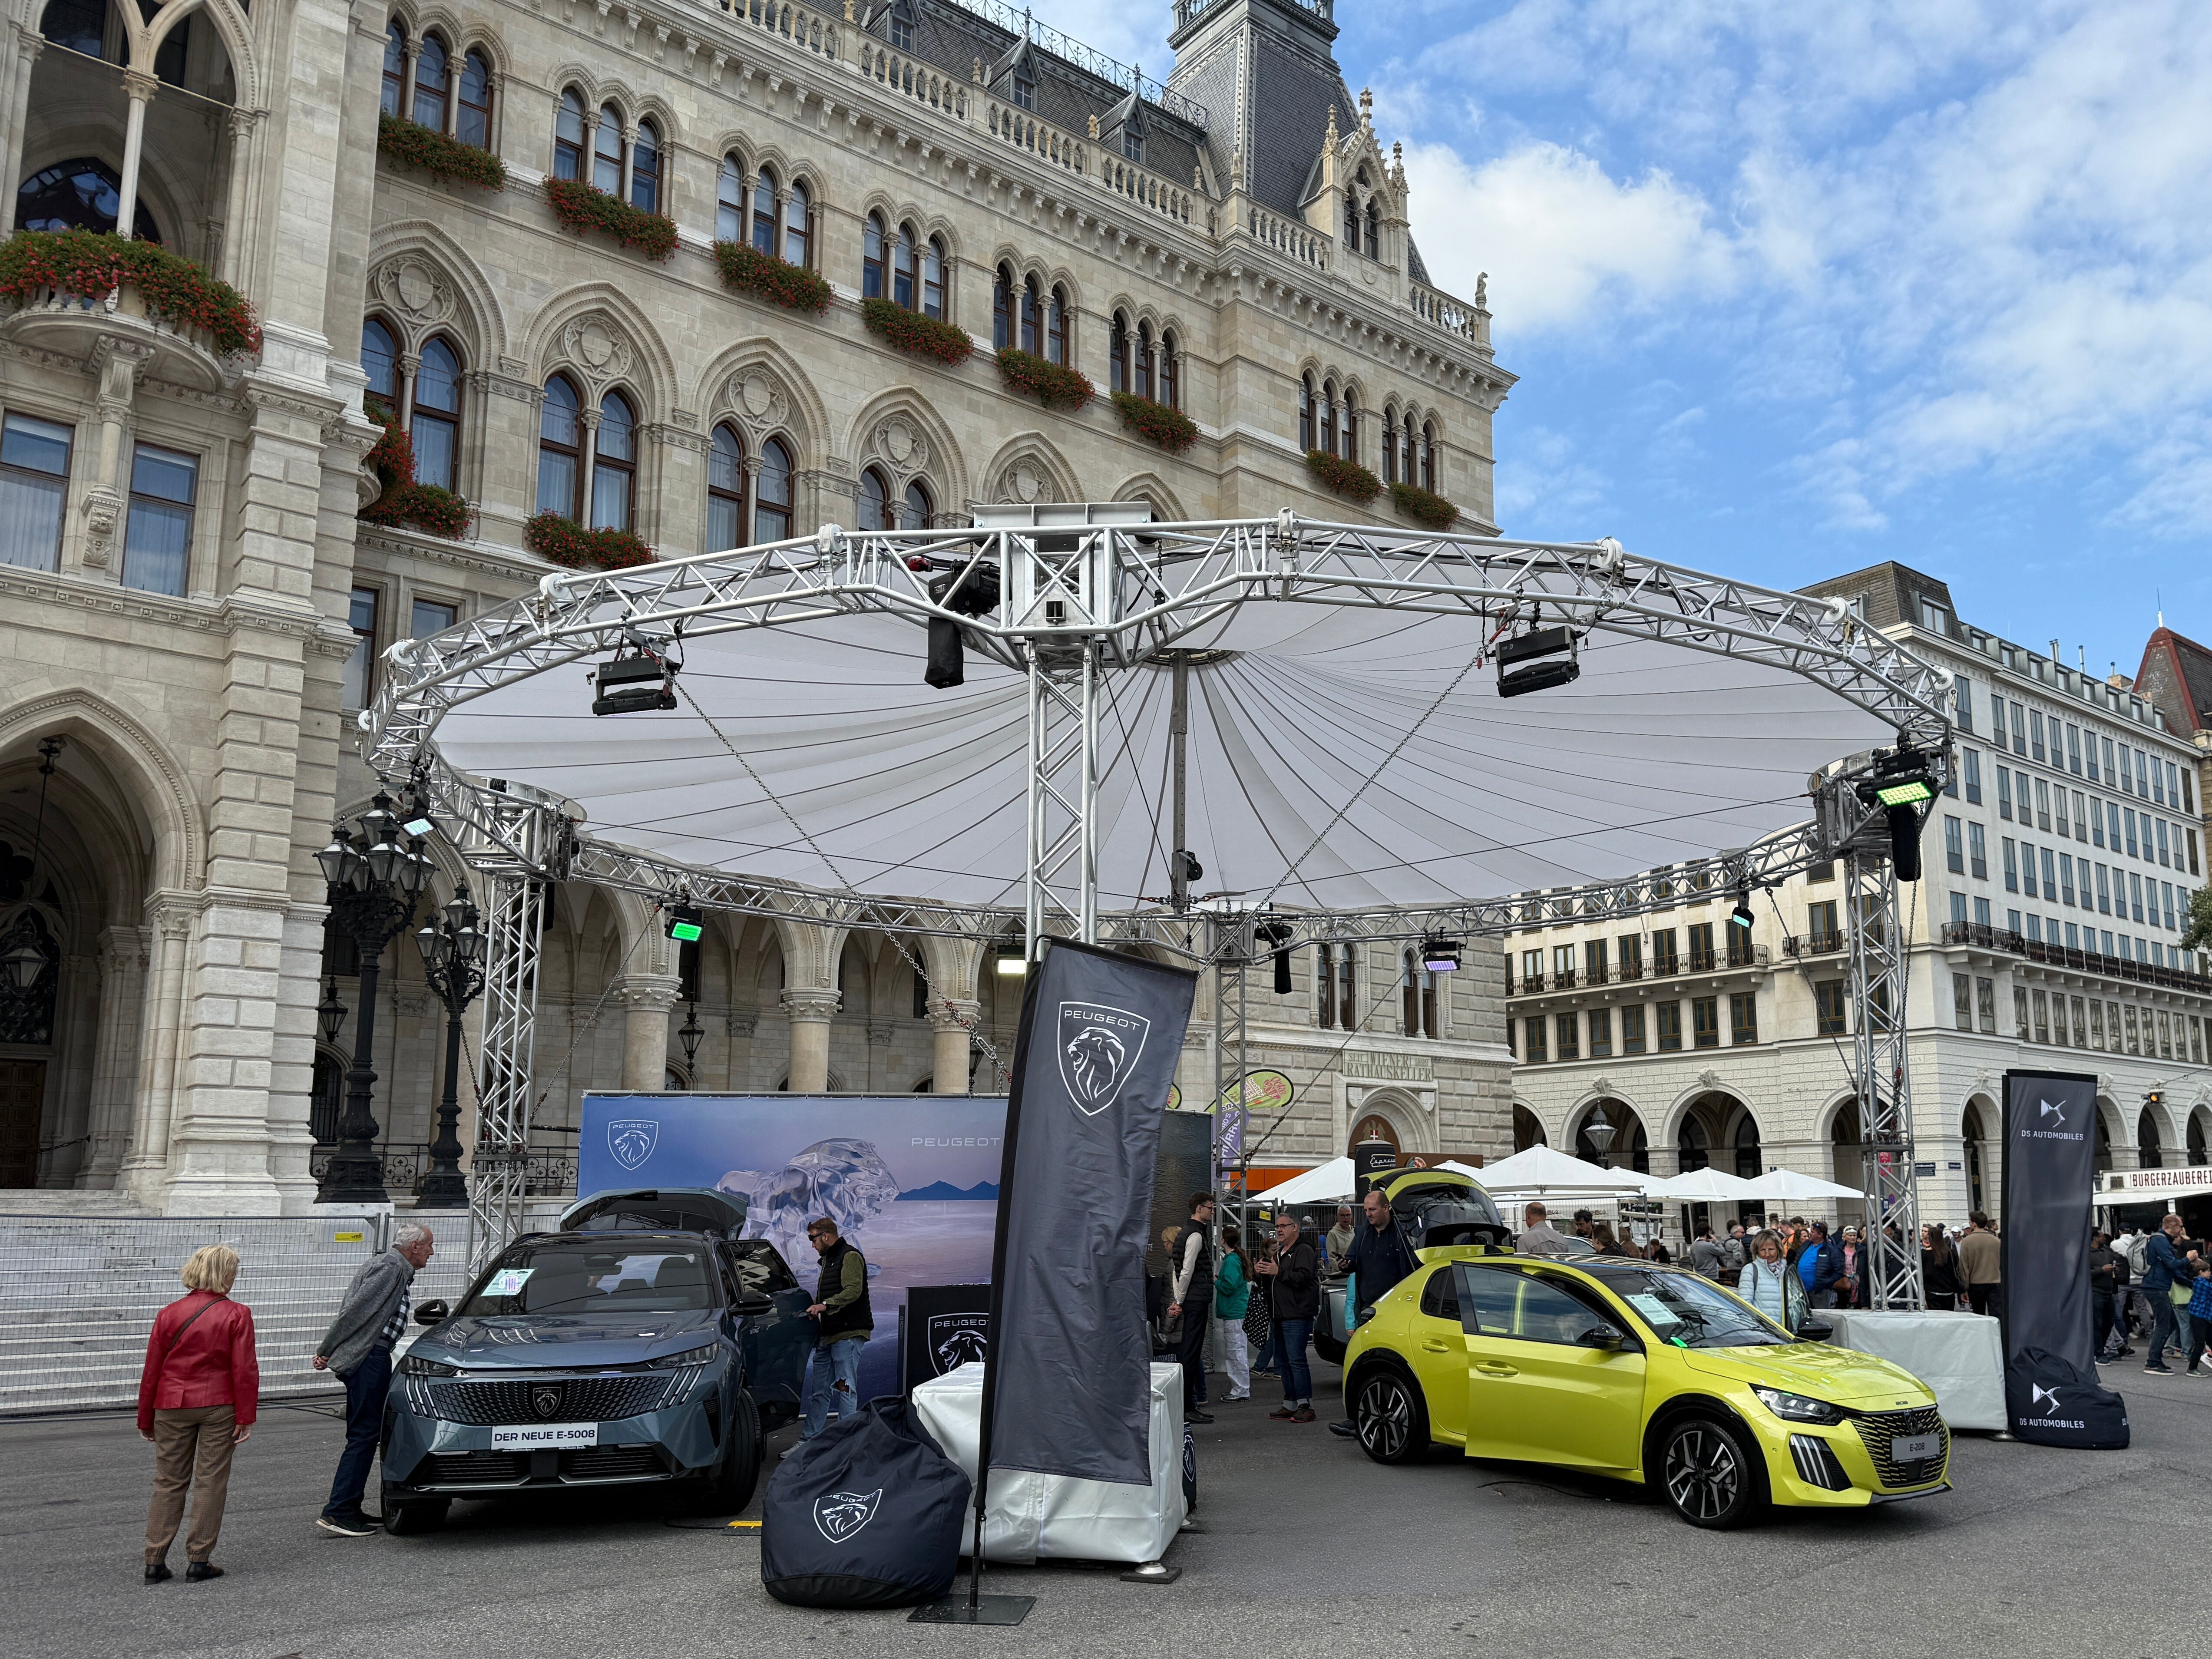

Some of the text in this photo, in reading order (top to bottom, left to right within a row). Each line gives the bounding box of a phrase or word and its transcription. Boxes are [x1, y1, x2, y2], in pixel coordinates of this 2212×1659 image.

[1065, 1010, 1140, 1030] PEUGEOT
[1349, 1052, 1429, 1068] SEIT WIENER 1899
[1347, 1062, 1433, 1081] RATHAUSKELLER
[2033, 1131, 2083, 1140] AUTOMOBILES
[911, 1137, 1000, 1147] PEUGEOT
[2133, 1170, 2212, 1187] BURGERZAUBEREI
[934, 1319, 989, 1329] PEUGEO
[2029, 1418, 2085, 1428] AUTOMOBILES
[494, 1429, 595, 1442] DER NEUE E-5008
[1909, 1442, 1925, 1452] E-208
